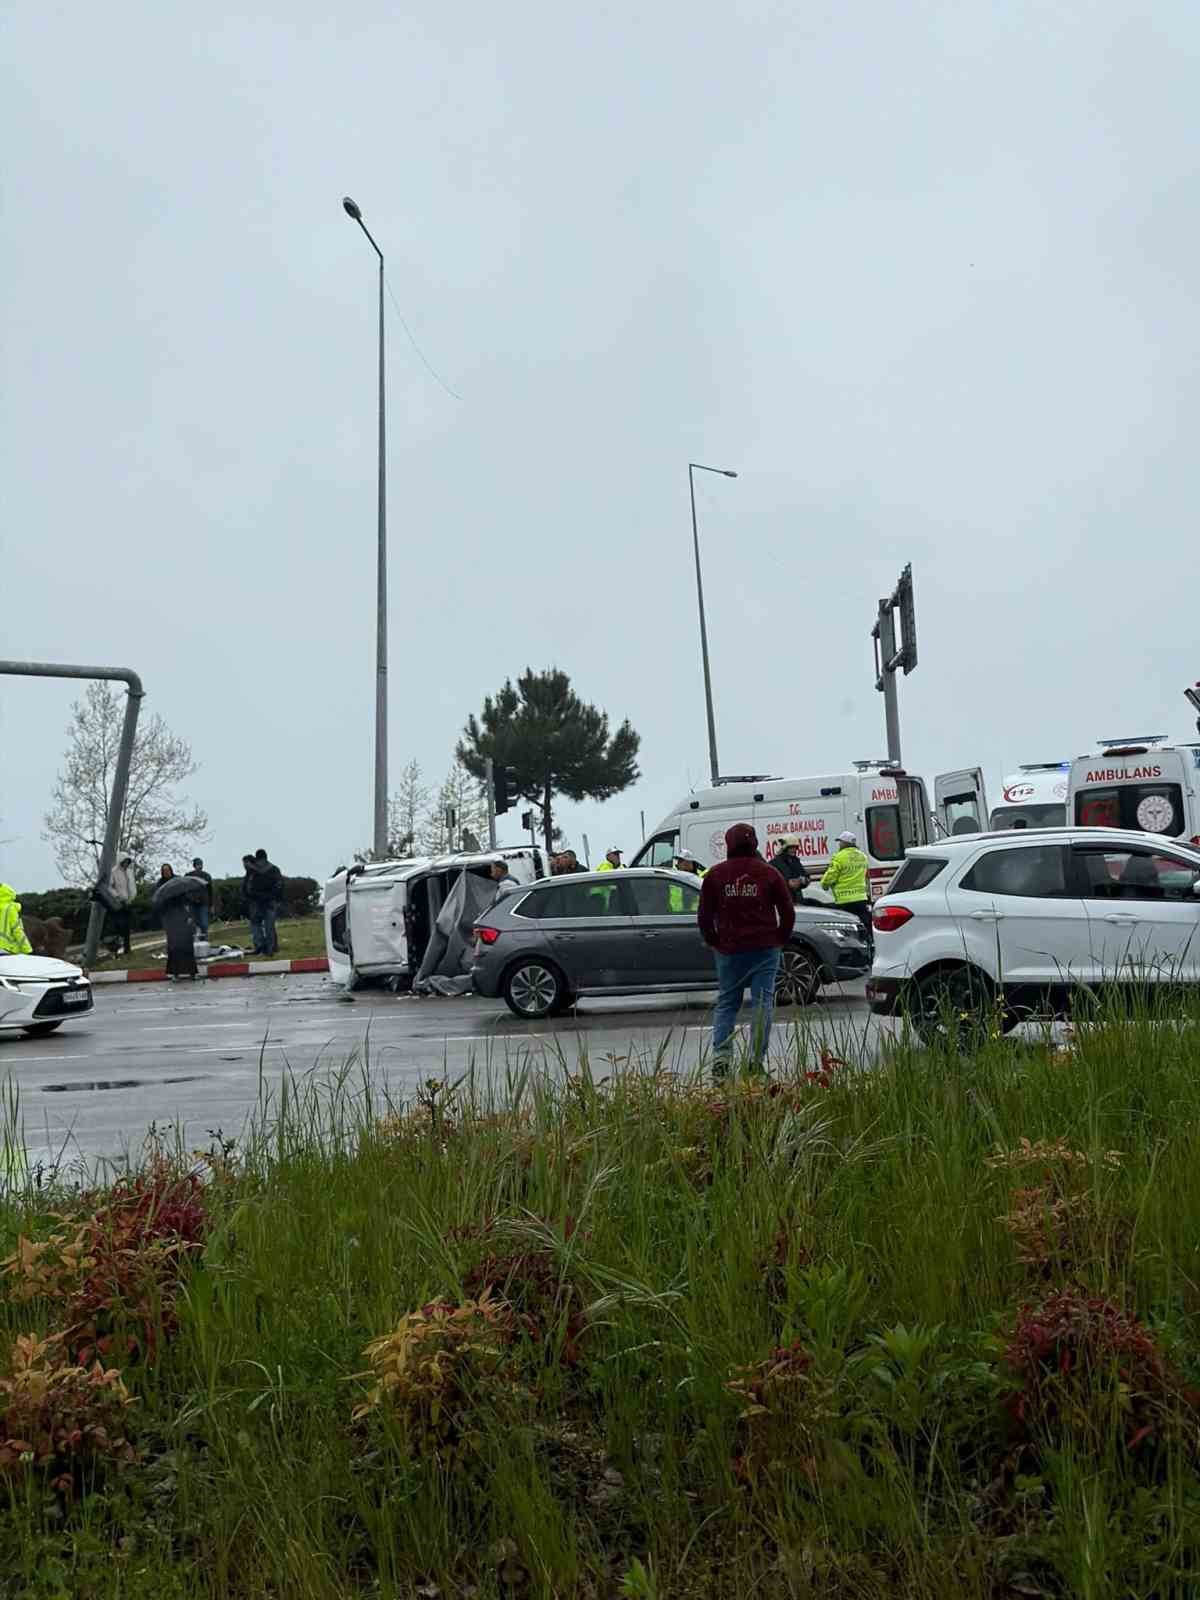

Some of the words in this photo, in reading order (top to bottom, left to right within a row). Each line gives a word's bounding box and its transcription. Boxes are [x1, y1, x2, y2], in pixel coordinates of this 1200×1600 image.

[1086, 766, 1161, 782] AMBULANS
[1010, 788, 1035, 797] 112
[794, 836, 829, 857] AĞLIK
